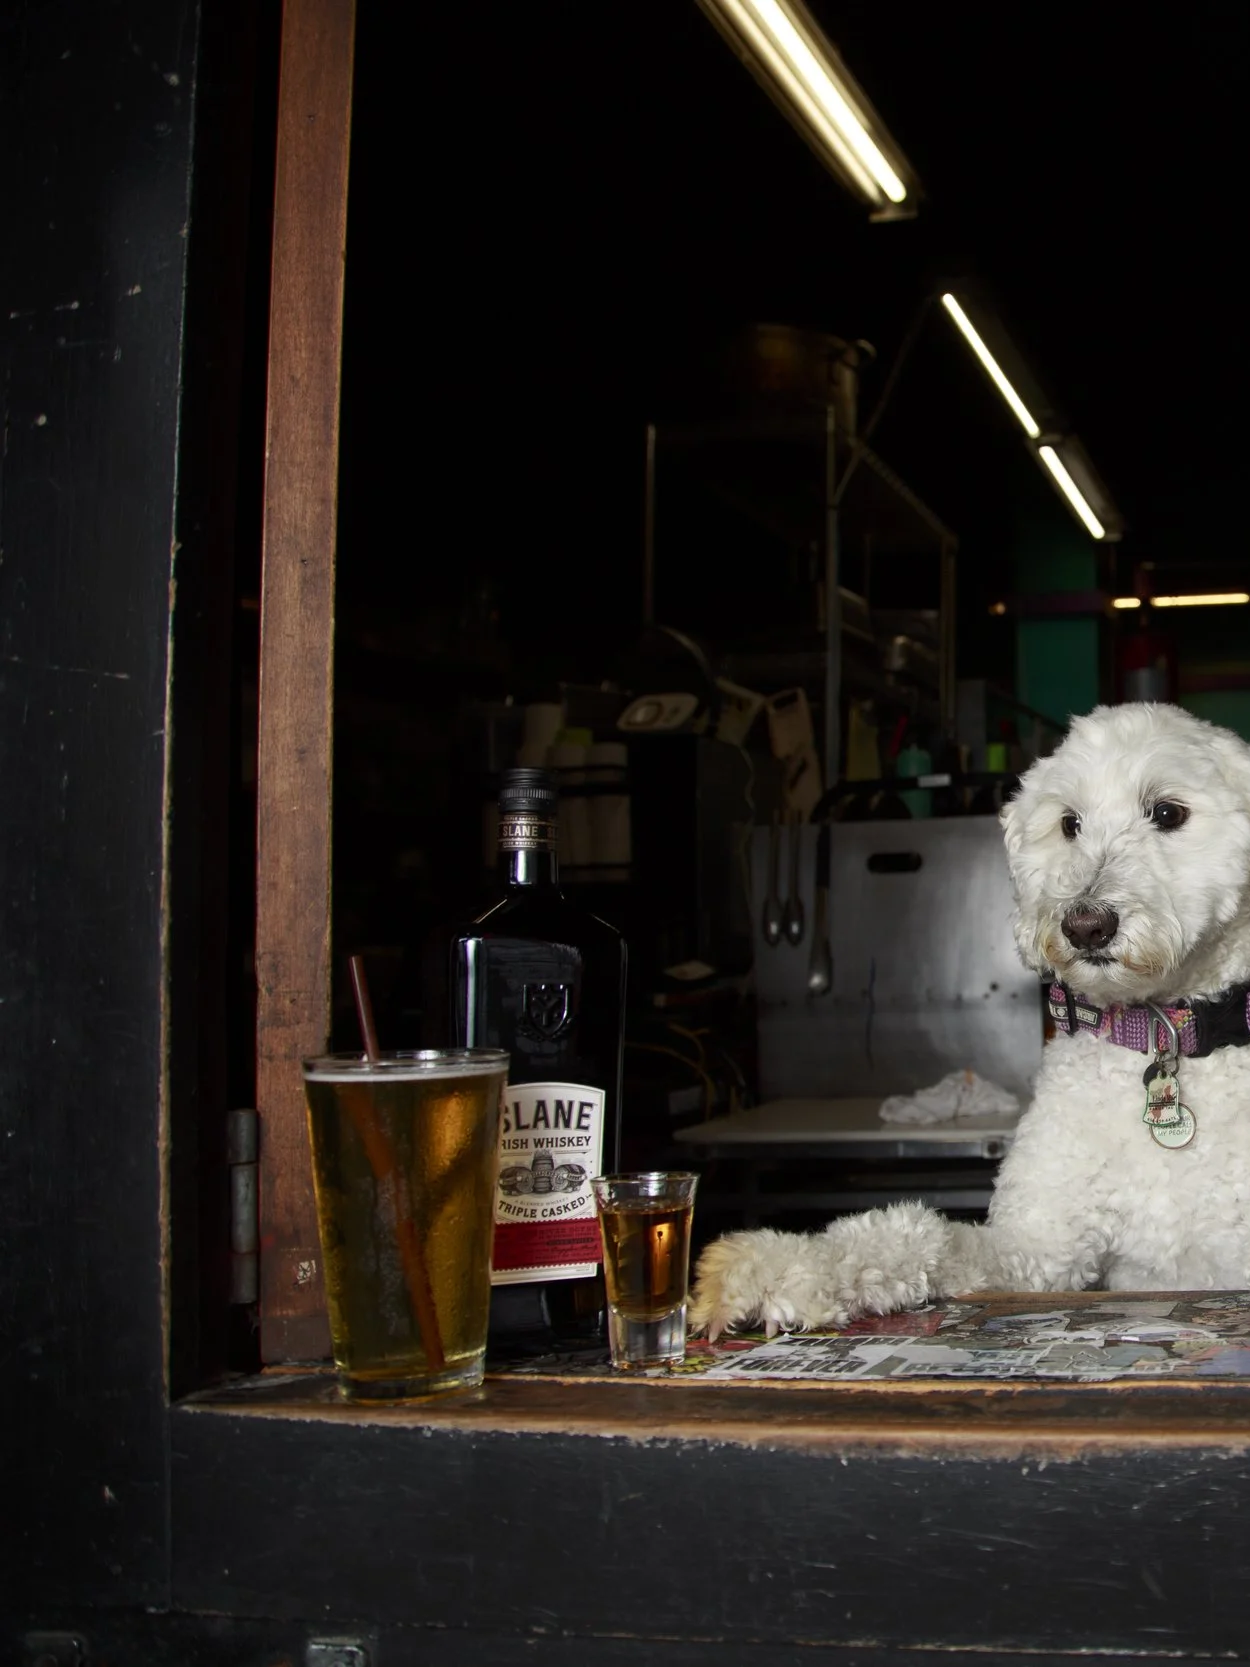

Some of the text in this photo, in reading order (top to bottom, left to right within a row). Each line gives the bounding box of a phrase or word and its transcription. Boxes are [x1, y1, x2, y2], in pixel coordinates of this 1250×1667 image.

[502, 825, 538, 837] SLANE
[501, 1135, 592, 1150] RISH WHISKEY
[498, 1196, 586, 1218] TRIPLE CASKED
